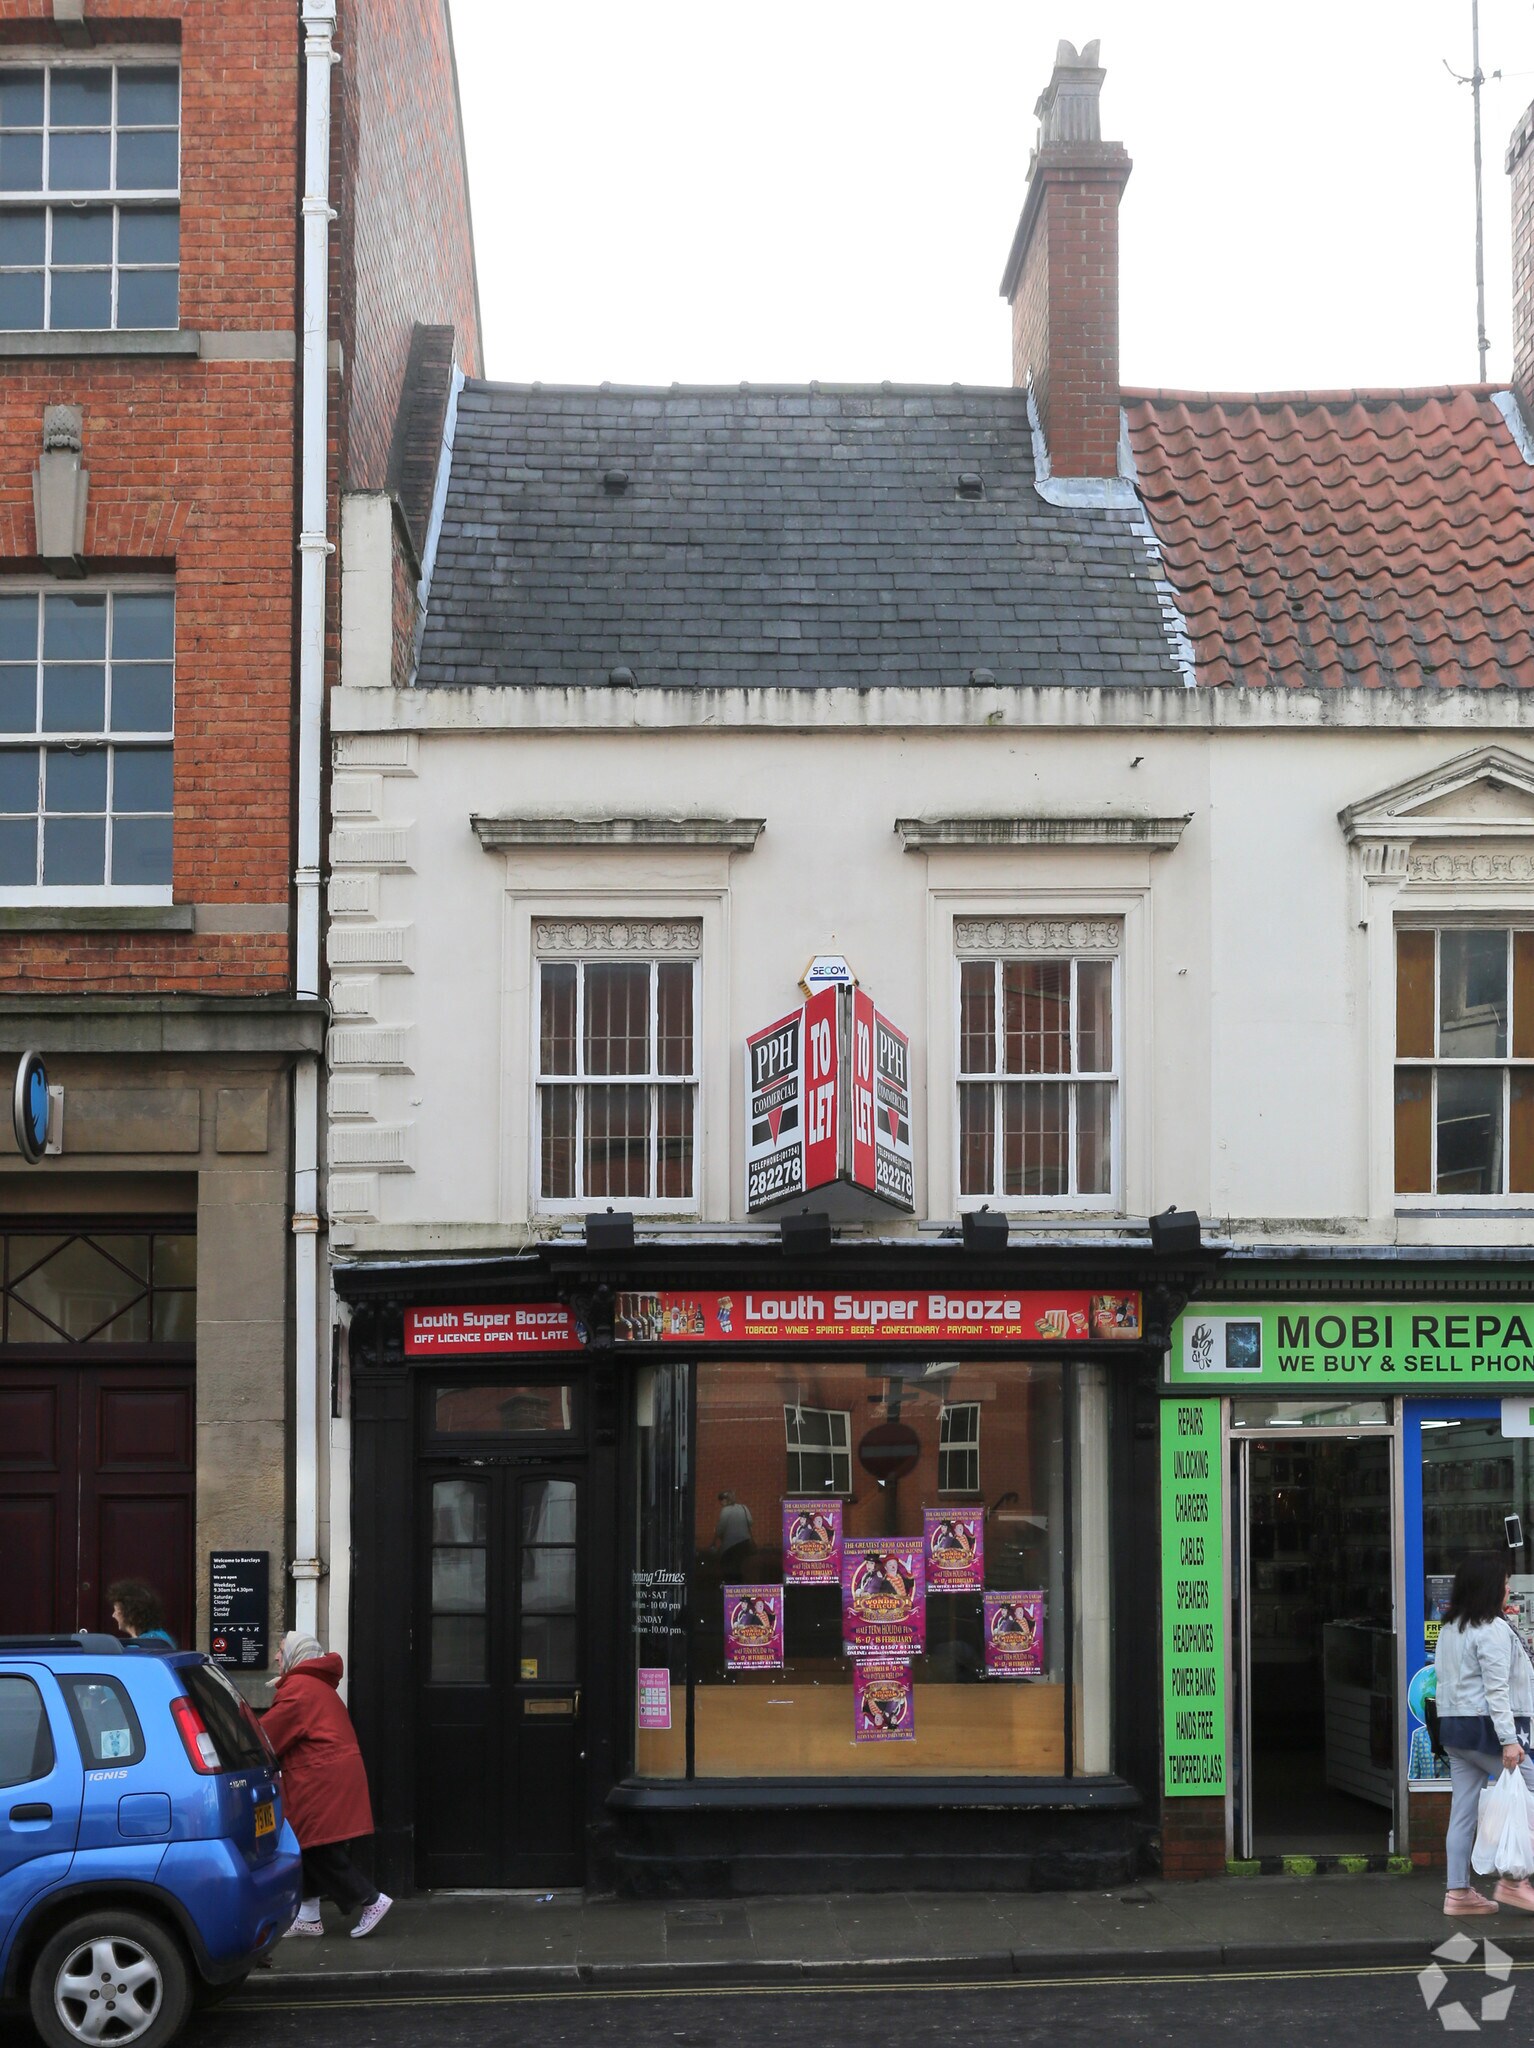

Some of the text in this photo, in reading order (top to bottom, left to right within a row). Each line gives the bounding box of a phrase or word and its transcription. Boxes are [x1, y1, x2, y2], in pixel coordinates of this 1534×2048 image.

[812, 966, 846, 975] SECOM
[756, 1029, 794, 1084] PPH
[810, 1018, 831, 1080] TO
[858, 1019, 870, 1082] TO
[880, 1030, 904, 1083] PPH
[754, 1082, 796, 1114] COMMERCIAL
[877, 1083, 908, 1113] COMMERCIAL
[808, 1080, 834, 1146] LET
[855, 1083, 872, 1147] LET
[750, 1157, 802, 1198] 282278
[878, 1158, 912, 1196] 282278
[414, 1310, 568, 1329] Louth Super Booze
[746, 1295, 1021, 1325] Louth Super Booze
[414, 1331, 568, 1344] OFF LICENCE OPEN TILL LATE
[744, 1326, 1022, 1334] TOBACCO WINES SPIRITS BEERS CONFECTIONARY PAYPOINT TOP UPS
[1277, 1315, 1533, 1349] MOBI REPA
[1278, 1355, 1534, 1372] WE BUY & SELL PHON
[1178, 1407, 1204, 1436] REPAIRS
[1174, 1451, 1208, 1479] UNLOCKING
[1175, 1494, 1208, 1522] CHARGERS
[1180, 1537, 1204, 1566] CABLES
[655, 1569, 685, 1582] Times
[1177, 1580, 1209, 1610] SPEAKERS
[1173, 1624, 1213, 1653] HEADPHONES
[1172, 1667, 1216, 1696] POWER BANKS
[1176, 1711, 1213, 1740] HANDS FREE
[89, 1770, 128, 1781] IGNIS
[1169, 1754, 1222, 1784] TEMPERED GLASS
